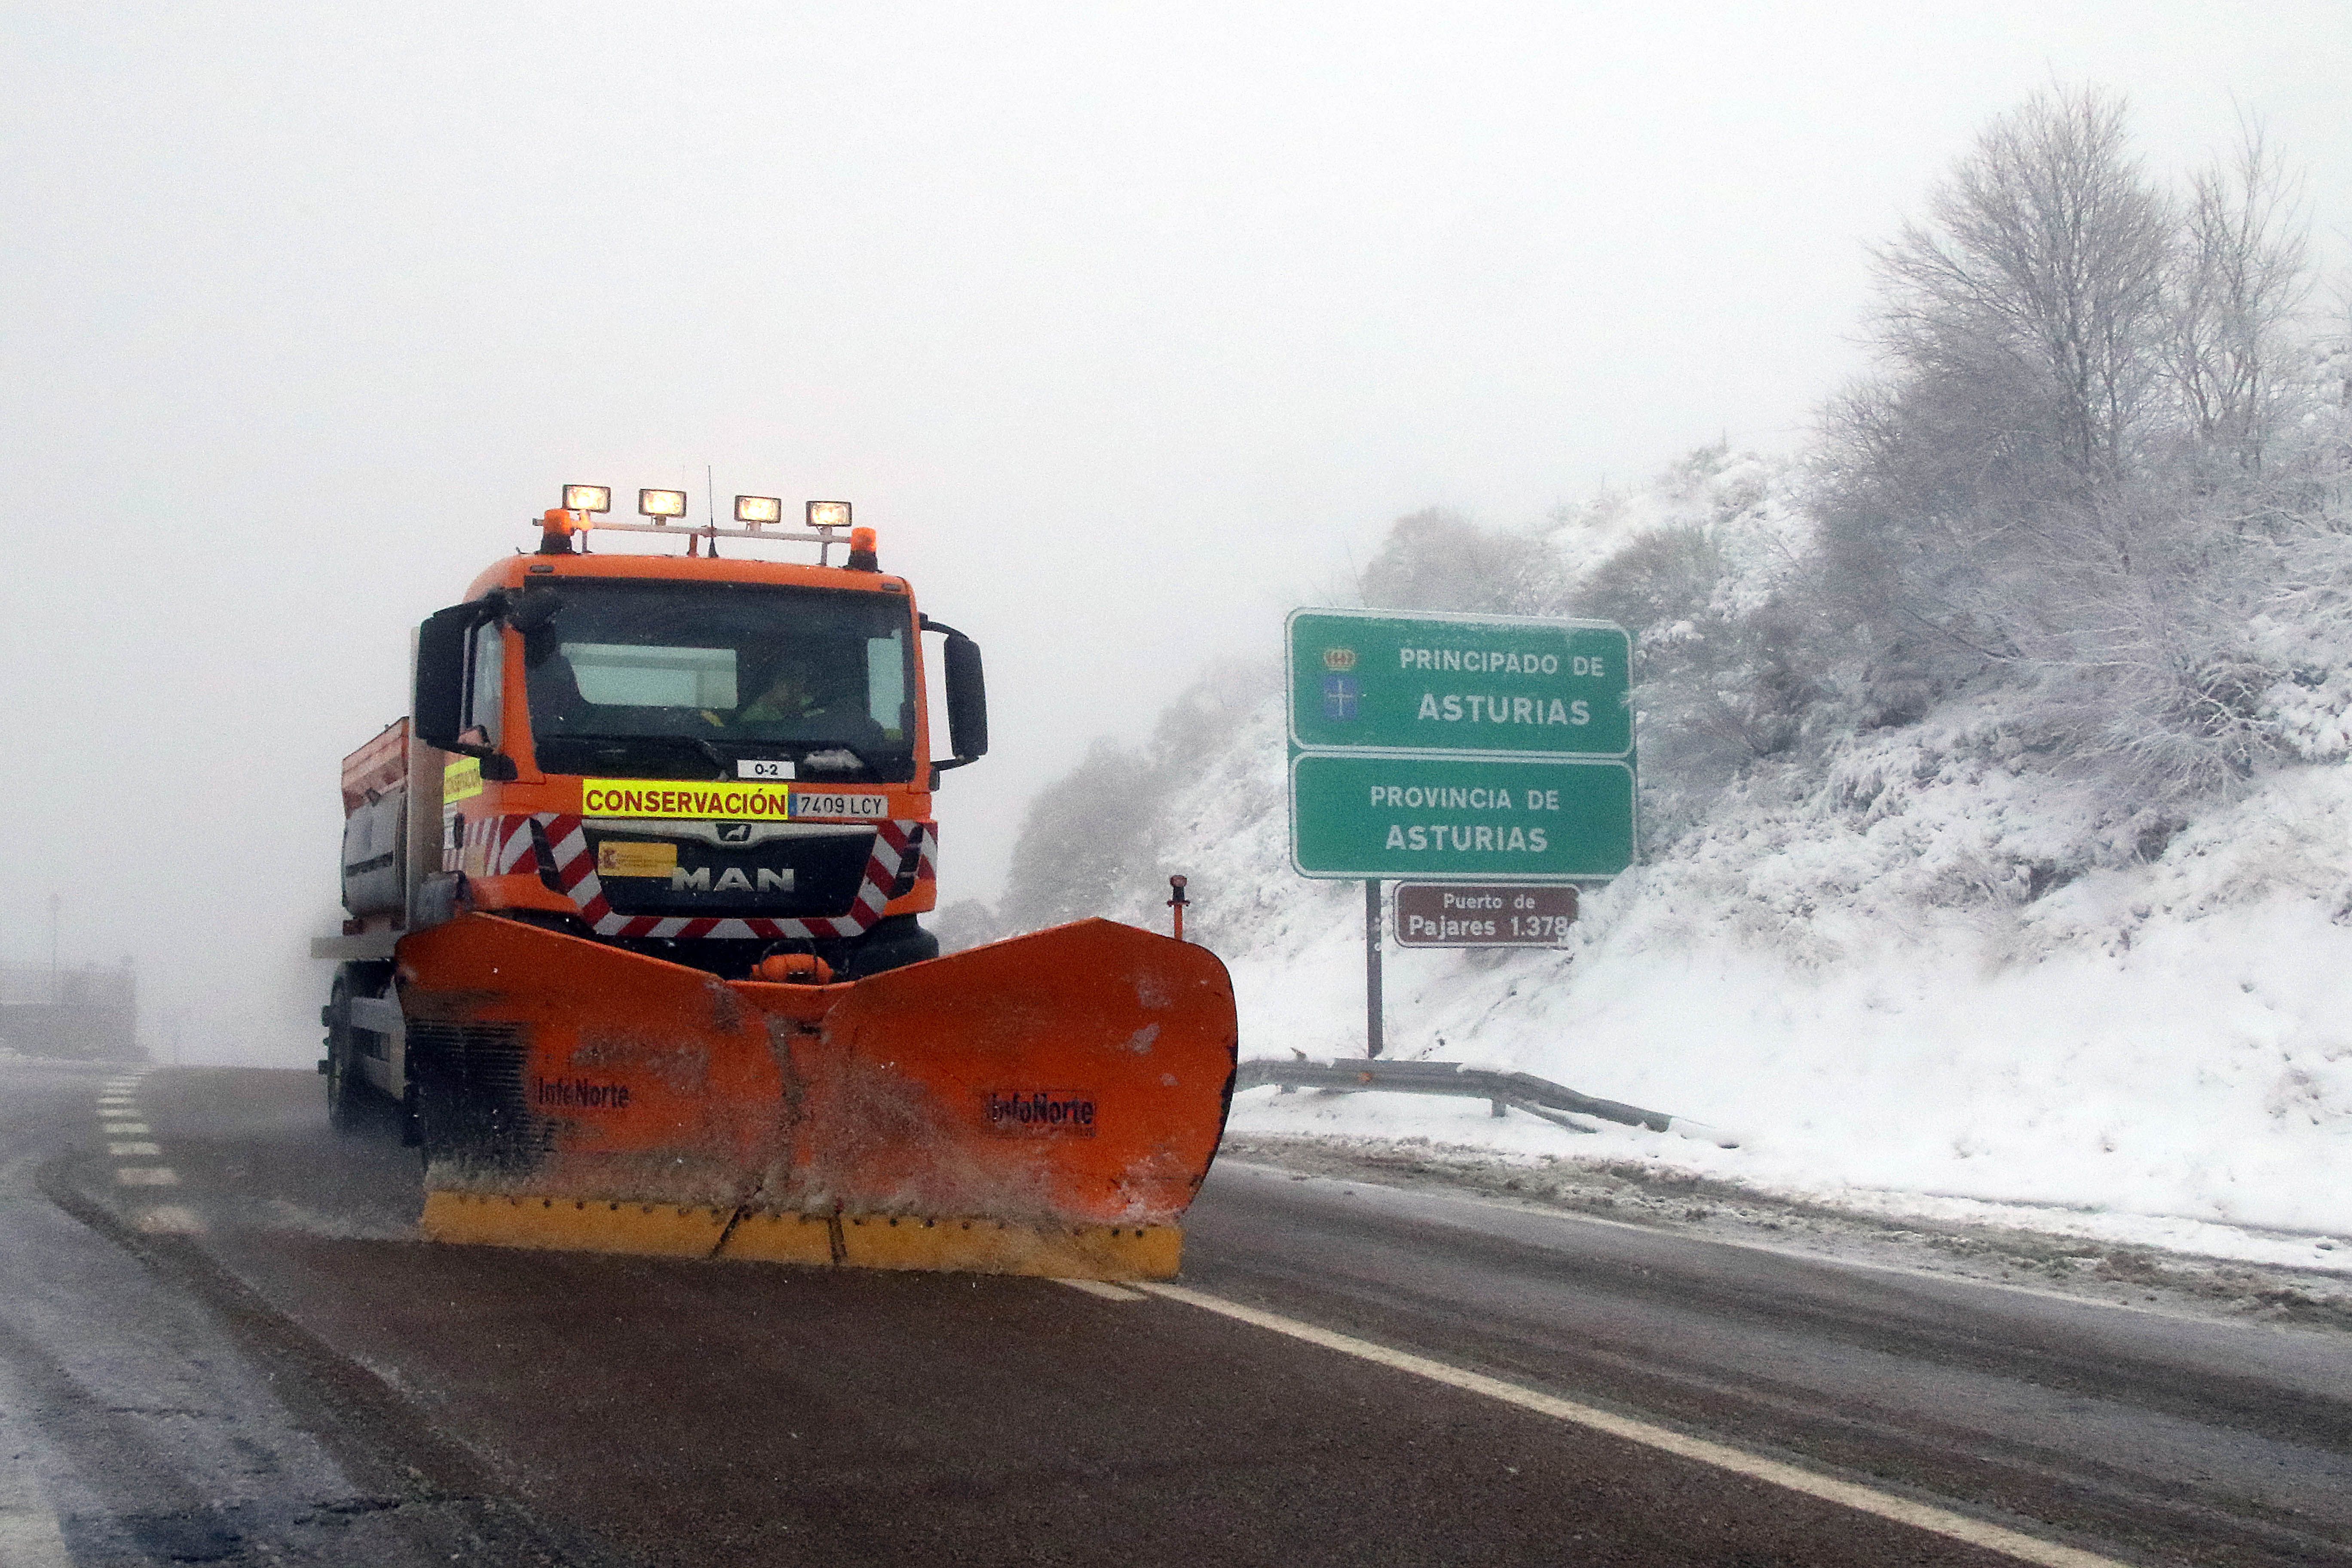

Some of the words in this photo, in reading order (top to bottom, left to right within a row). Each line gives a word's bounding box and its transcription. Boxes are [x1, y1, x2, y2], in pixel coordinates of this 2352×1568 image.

[1400, 648, 1558, 675] PRINCIPADO
[1574, 656, 1605, 677] DE
[1418, 693, 1591, 726] ASTURIAS
[586, 788, 786, 815] CONSERVACIÓN
[801, 796, 845, 813] 7409
[850, 798, 882, 814] LCY
[1370, 786, 1512, 809] PROVINCIA
[1528, 790, 1560, 810] DE
[1385, 825, 1548, 852] ASTURIAS
[672, 867, 795, 892] MAN
[1443, 893, 1503, 910] Puerto
[1514, 894, 1536, 910] de
[1409, 914, 1496, 940] Pajares
[1510, 916, 1569, 937] 1.378
